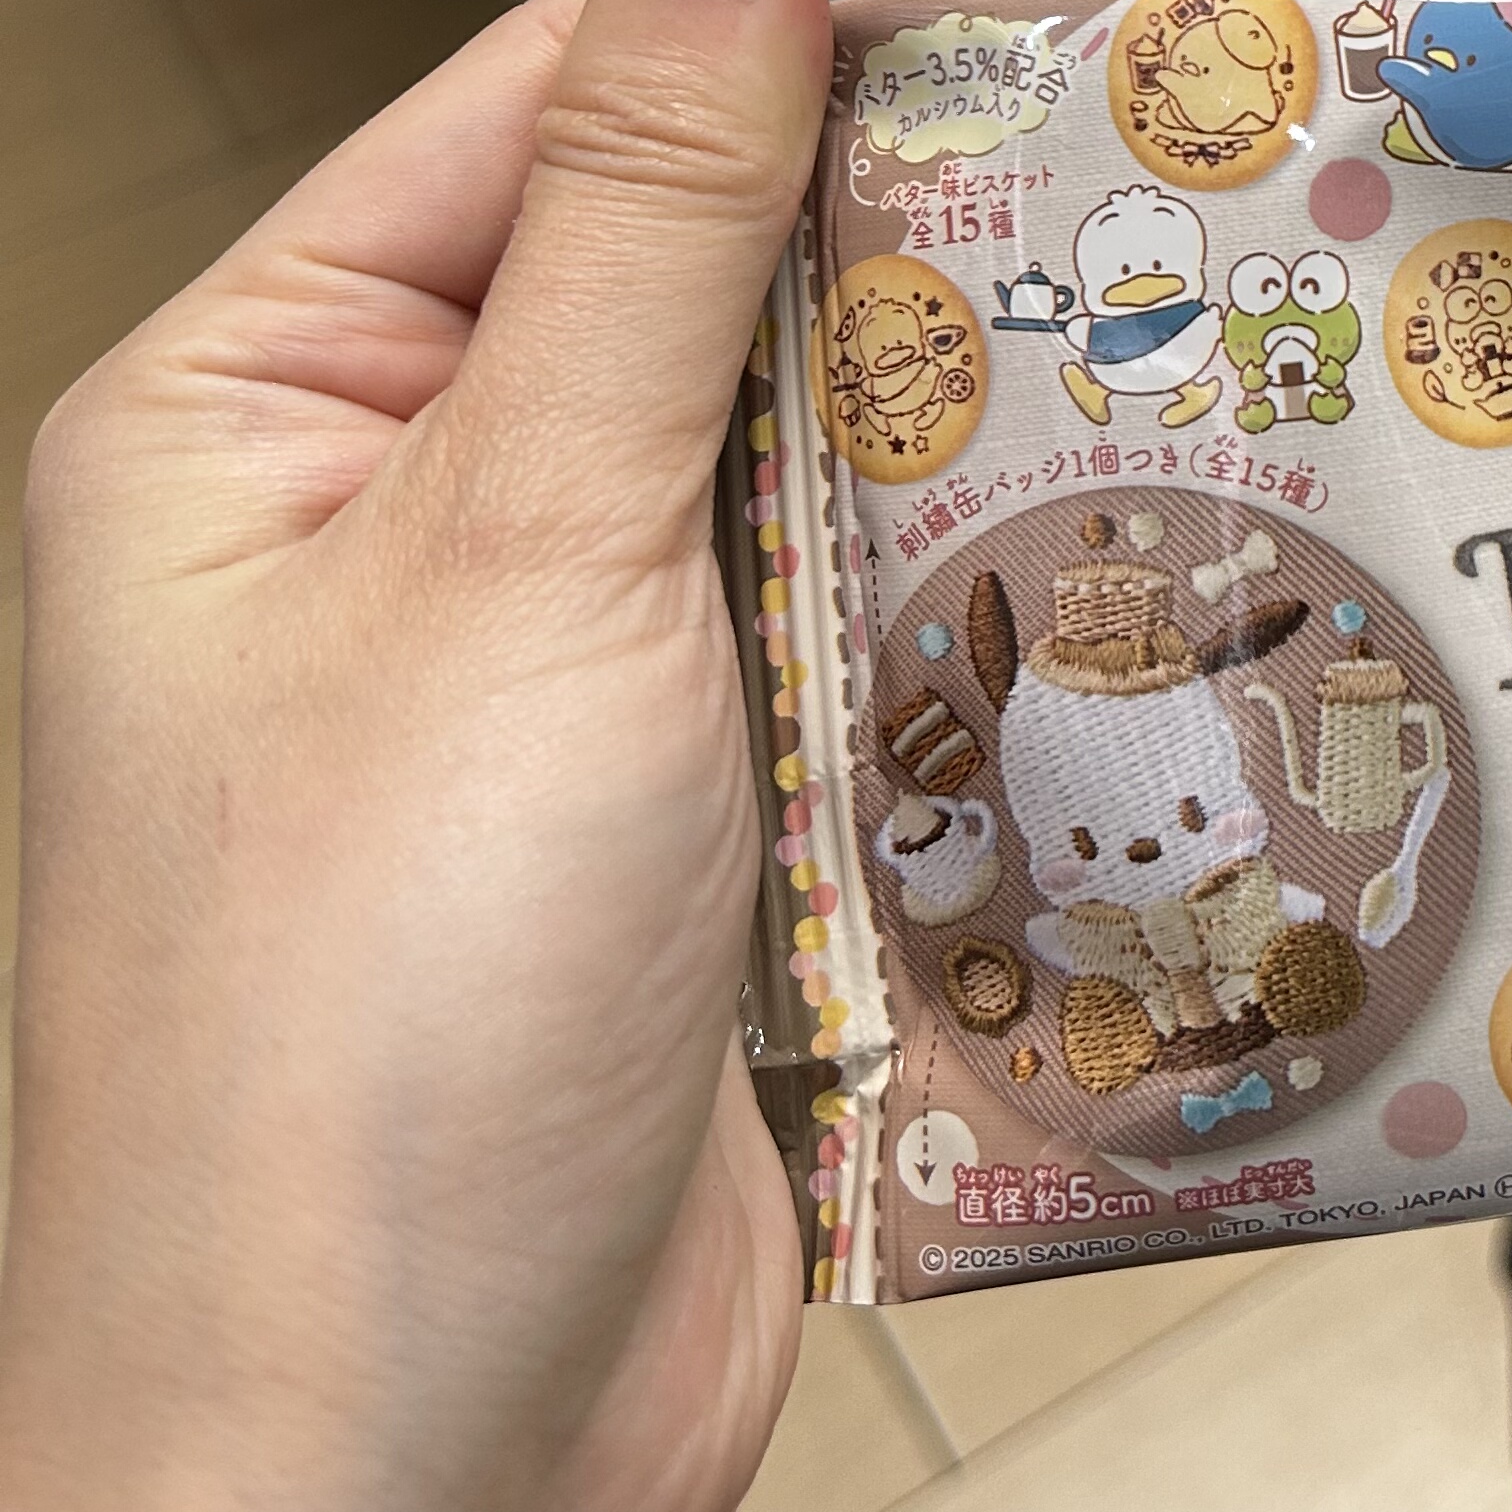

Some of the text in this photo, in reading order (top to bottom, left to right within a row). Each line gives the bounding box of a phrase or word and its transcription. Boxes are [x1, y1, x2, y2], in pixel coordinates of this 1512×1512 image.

[857, 47, 1070, 120] バター3.5%配合
[897, 92, 1022, 136] カルシウム入り
[883, 164, 1054, 206] バター味ビスケット
[911, 202, 1017, 250] 全15種
[958, 1175, 1152, 1223] 直径約5cm
[1027, 1236, 1136, 1264] SANRIO
[1211, 1218, 1273, 1239] LTD.
[1395, 1183, 1485, 1211] JAPAN
